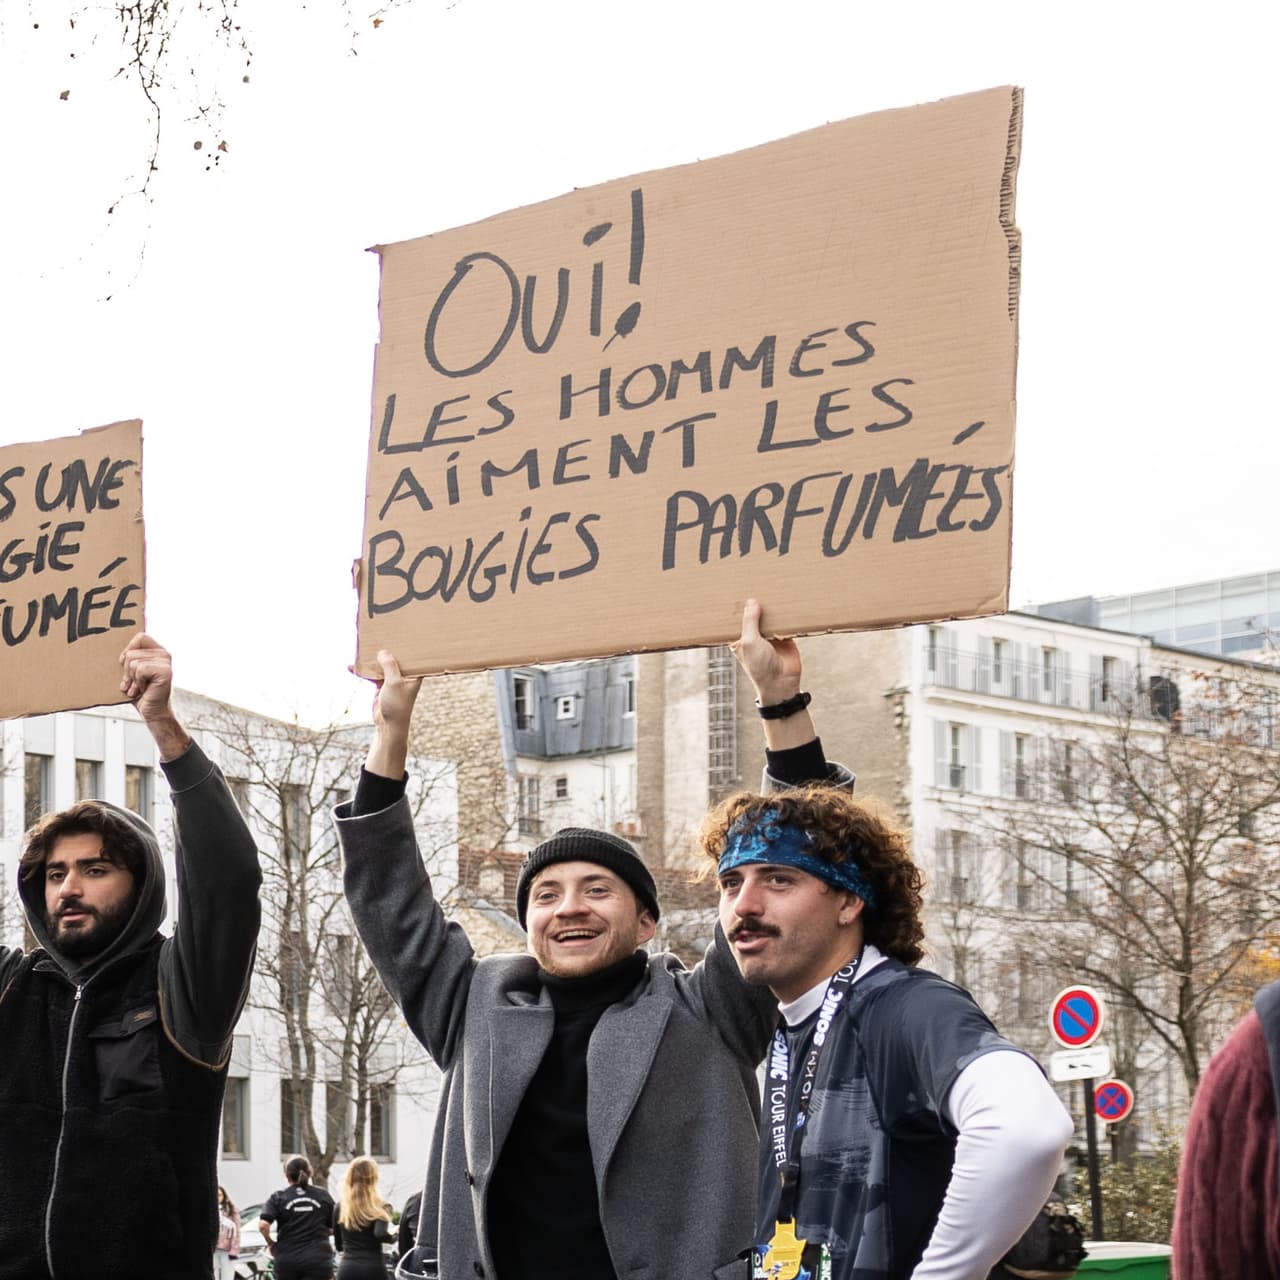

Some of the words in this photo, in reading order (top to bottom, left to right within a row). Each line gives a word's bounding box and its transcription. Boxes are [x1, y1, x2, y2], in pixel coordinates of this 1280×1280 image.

[378, 390, 516, 454] LES
[559, 321, 876, 420] HOMMES
[758, 378, 914, 453] LES
[35, 457, 138, 514] UNE
[813, 988, 843, 1047] SONIC
[833, 957, 858, 984] TOU
[770, 1029, 788, 1081] SONIC
[770, 1085, 786, 1124] TOUR
[772, 1125, 787, 1167] EIFFEL
